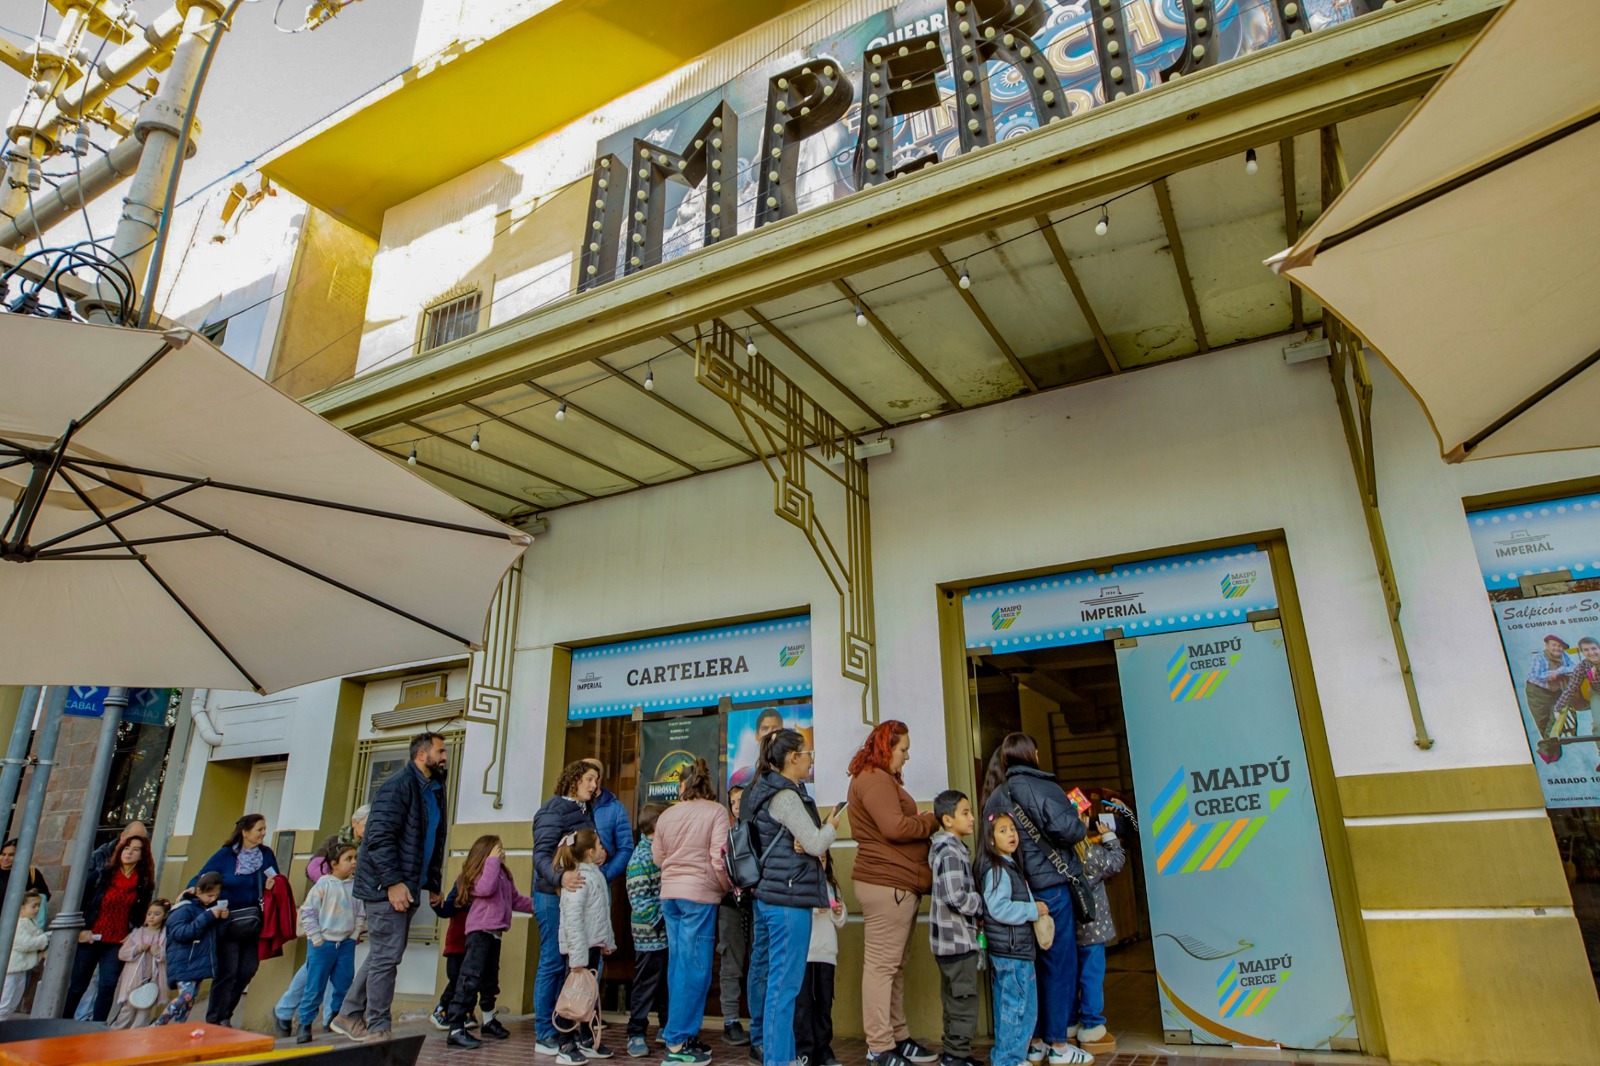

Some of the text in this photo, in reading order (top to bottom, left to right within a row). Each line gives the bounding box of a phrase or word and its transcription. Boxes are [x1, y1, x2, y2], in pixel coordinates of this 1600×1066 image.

[578, 0, 1400, 291] IMPERI
[1495, 542, 1554, 558] IMPERIAL
[1000, 604, 1021, 613] MAIPÚ
[1081, 602, 1146, 622] IMPERIAL
[1503, 602, 1562, 620] Salpicón
[1579, 599, 1600, 612] So
[1525, 619, 1557, 628] CUMPAS
[1568, 615, 1598, 624] SERGIO
[1188, 636, 1241, 658] MAIPÚ
[626, 655, 749, 686] CARTELERA
[1190, 657, 1226, 670] CRECE
[577, 682, 602, 690] IMPERIAL
[65, 700, 97, 711] CABAL
[1191, 756, 1290, 793] MAIPÚ
[1547, 777, 1587, 785] SABADO
[648, 785, 678, 796] JURASSIC
[1194, 793, 1261, 817] CRECE
[1014, 804, 1041, 843] TROPEA
[1238, 954, 1292, 974] MAIPÚ
[1240, 974, 1276, 987] CRECE
